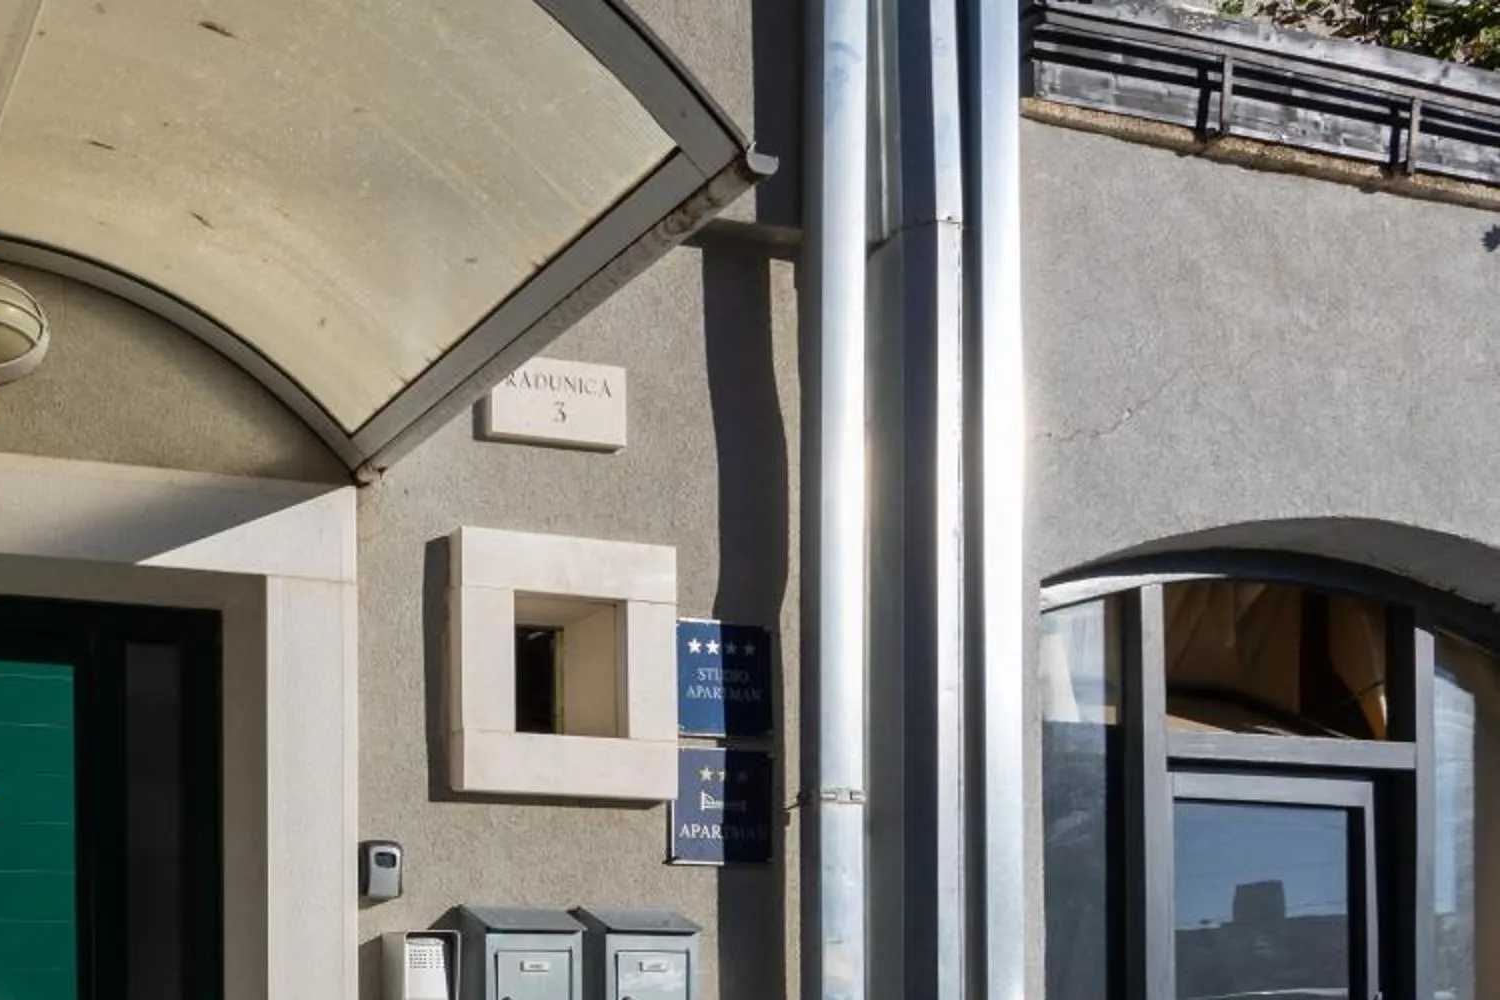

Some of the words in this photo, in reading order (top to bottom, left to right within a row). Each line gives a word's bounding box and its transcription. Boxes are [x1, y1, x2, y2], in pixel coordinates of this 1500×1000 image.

[506, 368, 612, 399] RADUNICA
[551, 400, 567, 424] 3
[697, 667, 750, 683] STUDIO
